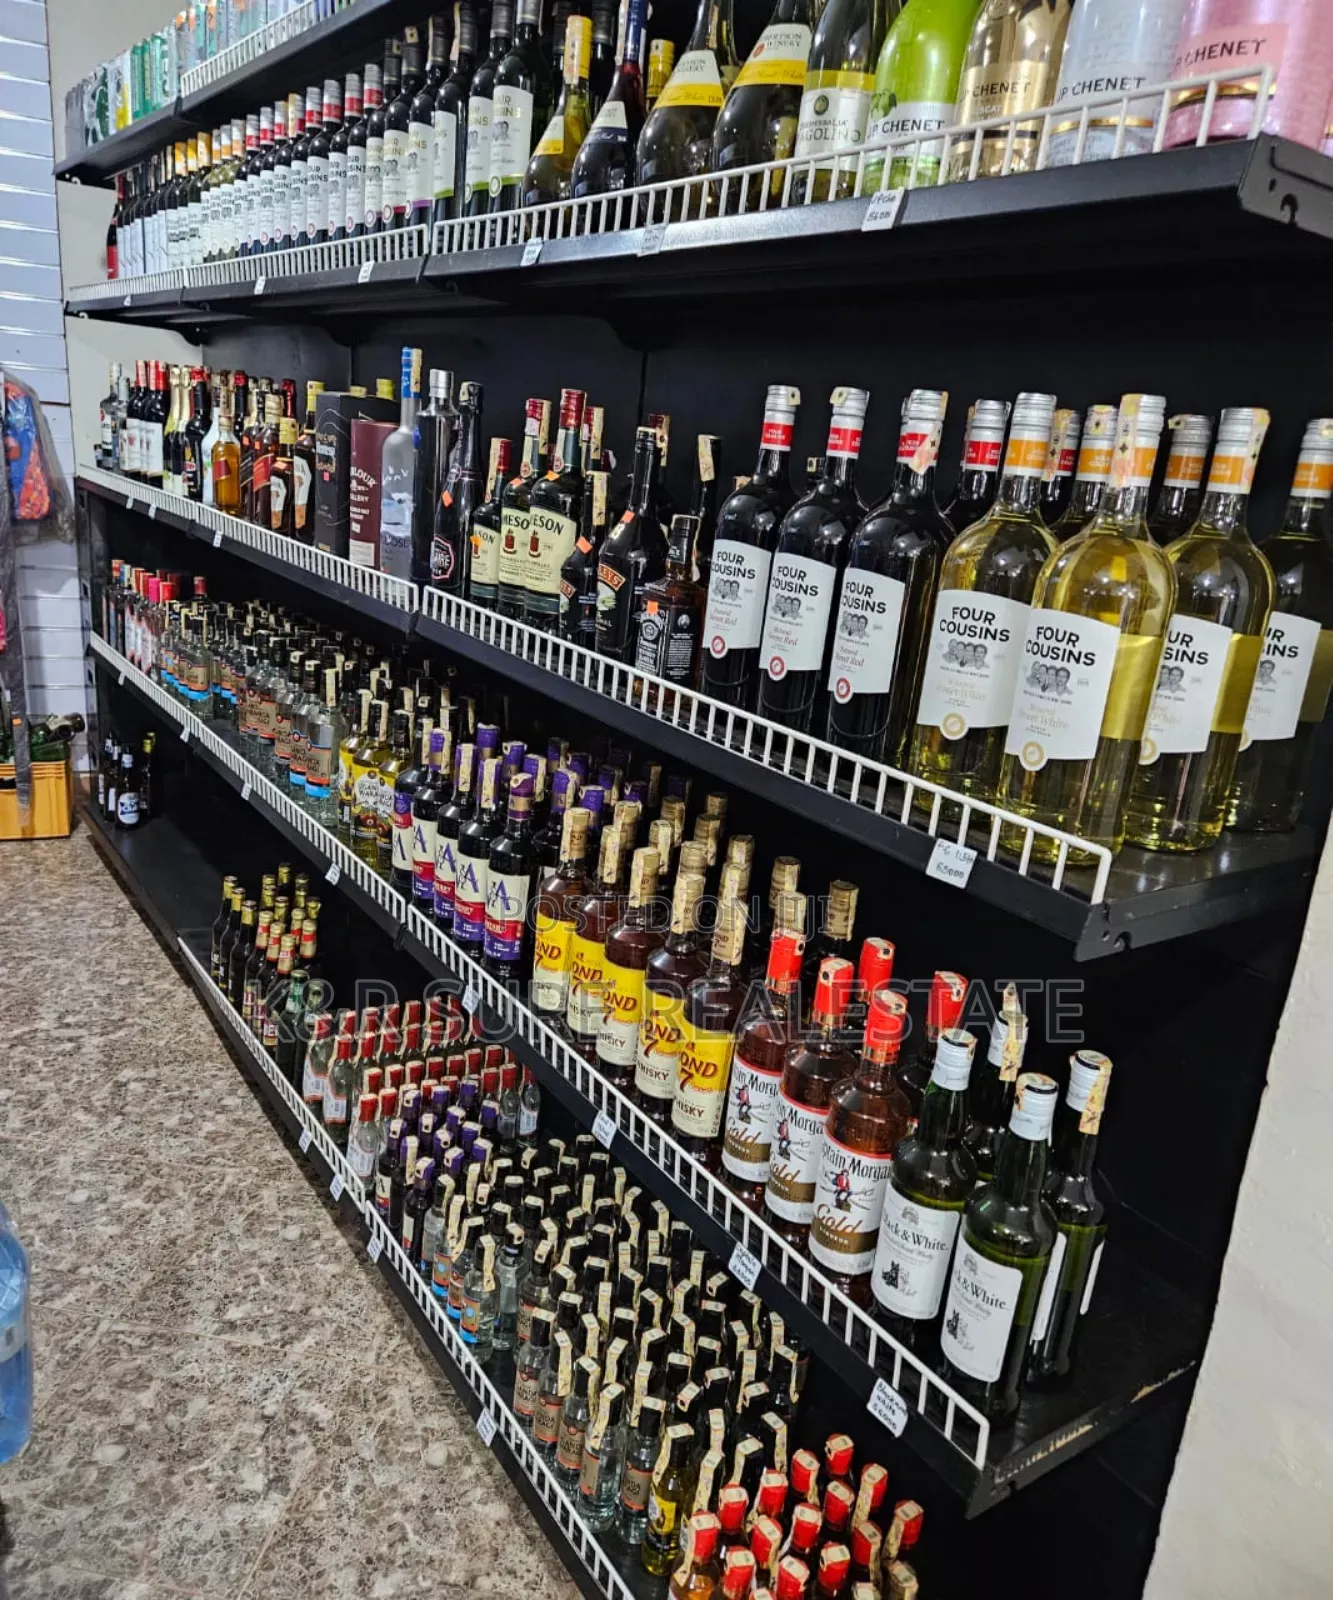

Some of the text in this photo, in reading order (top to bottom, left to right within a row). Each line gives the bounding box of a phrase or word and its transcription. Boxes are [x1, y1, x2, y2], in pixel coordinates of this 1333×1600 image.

[1184, 38, 1267, 67] CHENET
[972, 82, 1031, 97] CHENET
[1071, 76, 1147, 96] CHENET
[881, 119, 945, 134] CHENET
[717, 550, 745, 566] FOUR
[777, 565, 807, 583] FOUR
[845, 581, 874, 599] FOUR
[952, 606, 996, 627] FOUR
[939, 619, 1011, 643] COUSINS
[1036, 625, 1080, 648] FOUR
[1167, 629, 1194, 649] UR
[1025, 639, 1096, 666] COUSINS
[1163, 647, 1210, 665] SINS
[572, 974, 582, 996] 7
[602, 1003, 615, 1026] 7
[643, 1019, 681, 1043] OND
[643, 1034, 659, 1059] 7
[680, 1050, 718, 1079] OND
[680, 1067, 694, 1093] 7
[816, 1203, 863, 1235] Gold
[912, 1231, 948, 1251] White
[970, 1281, 1007, 1309] White
